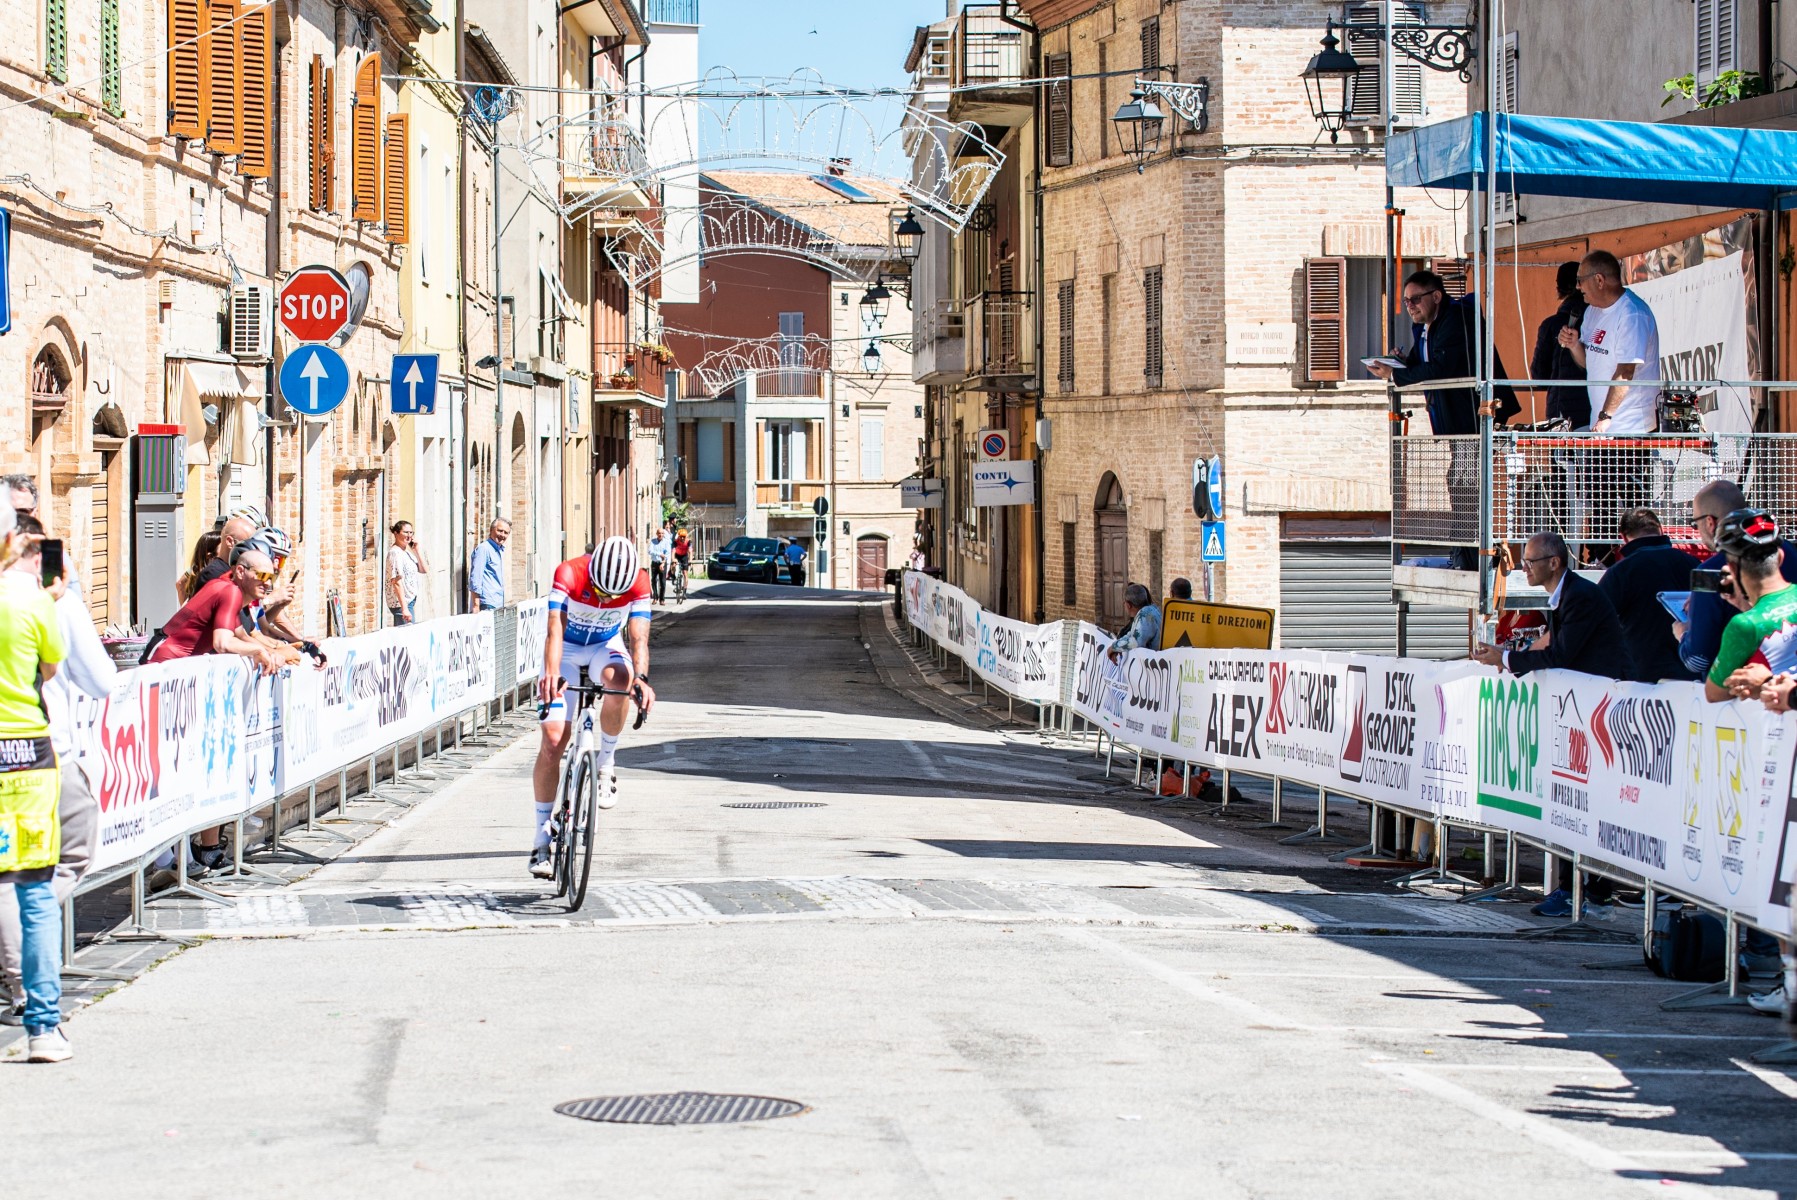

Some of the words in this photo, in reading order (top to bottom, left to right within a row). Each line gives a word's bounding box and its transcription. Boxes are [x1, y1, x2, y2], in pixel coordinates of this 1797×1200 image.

[284, 294, 345, 320] STOP
[1261, 346, 1288, 355] FEDERICI
[1262, 331, 1283, 340] NUOVO
[1660, 342, 1724, 392] ANTORI
[975, 471, 1007, 480] CONTI
[1170, 609, 1195, 623] TUTTE
[1201, 612, 1211, 624] LE
[1217, 614, 1267, 630] DIREZIONI
[1208, 660, 1265, 683] CALZATURIFICIO
[1284, 670, 1337, 734] OVERKART
[1385, 671, 1416, 713] ISTAL
[1205, 692, 1264, 760] ALEX
[1366, 712, 1416, 757] GRONDE
[1478, 677, 1539, 794] MACAP
[1266, 739, 1286, 762] Printing
[1287, 742, 1295, 760] and
[1295, 742, 1314, 768] Packaging
[1314, 747, 1335, 768] Solutions
[1421, 741, 1468, 775] MALAIGIA
[1364, 756, 1412, 791] COSTRUZIONI
[1421, 783, 1468, 808] PELLAMI
[1551, 782, 1573, 807] IMPRESA
[1574, 791, 1589, 813] EDILE
[1598, 819, 1636, 860] PAVIMENTAZIONI
[1635, 830, 1667, 871] INDUSTRIALI
